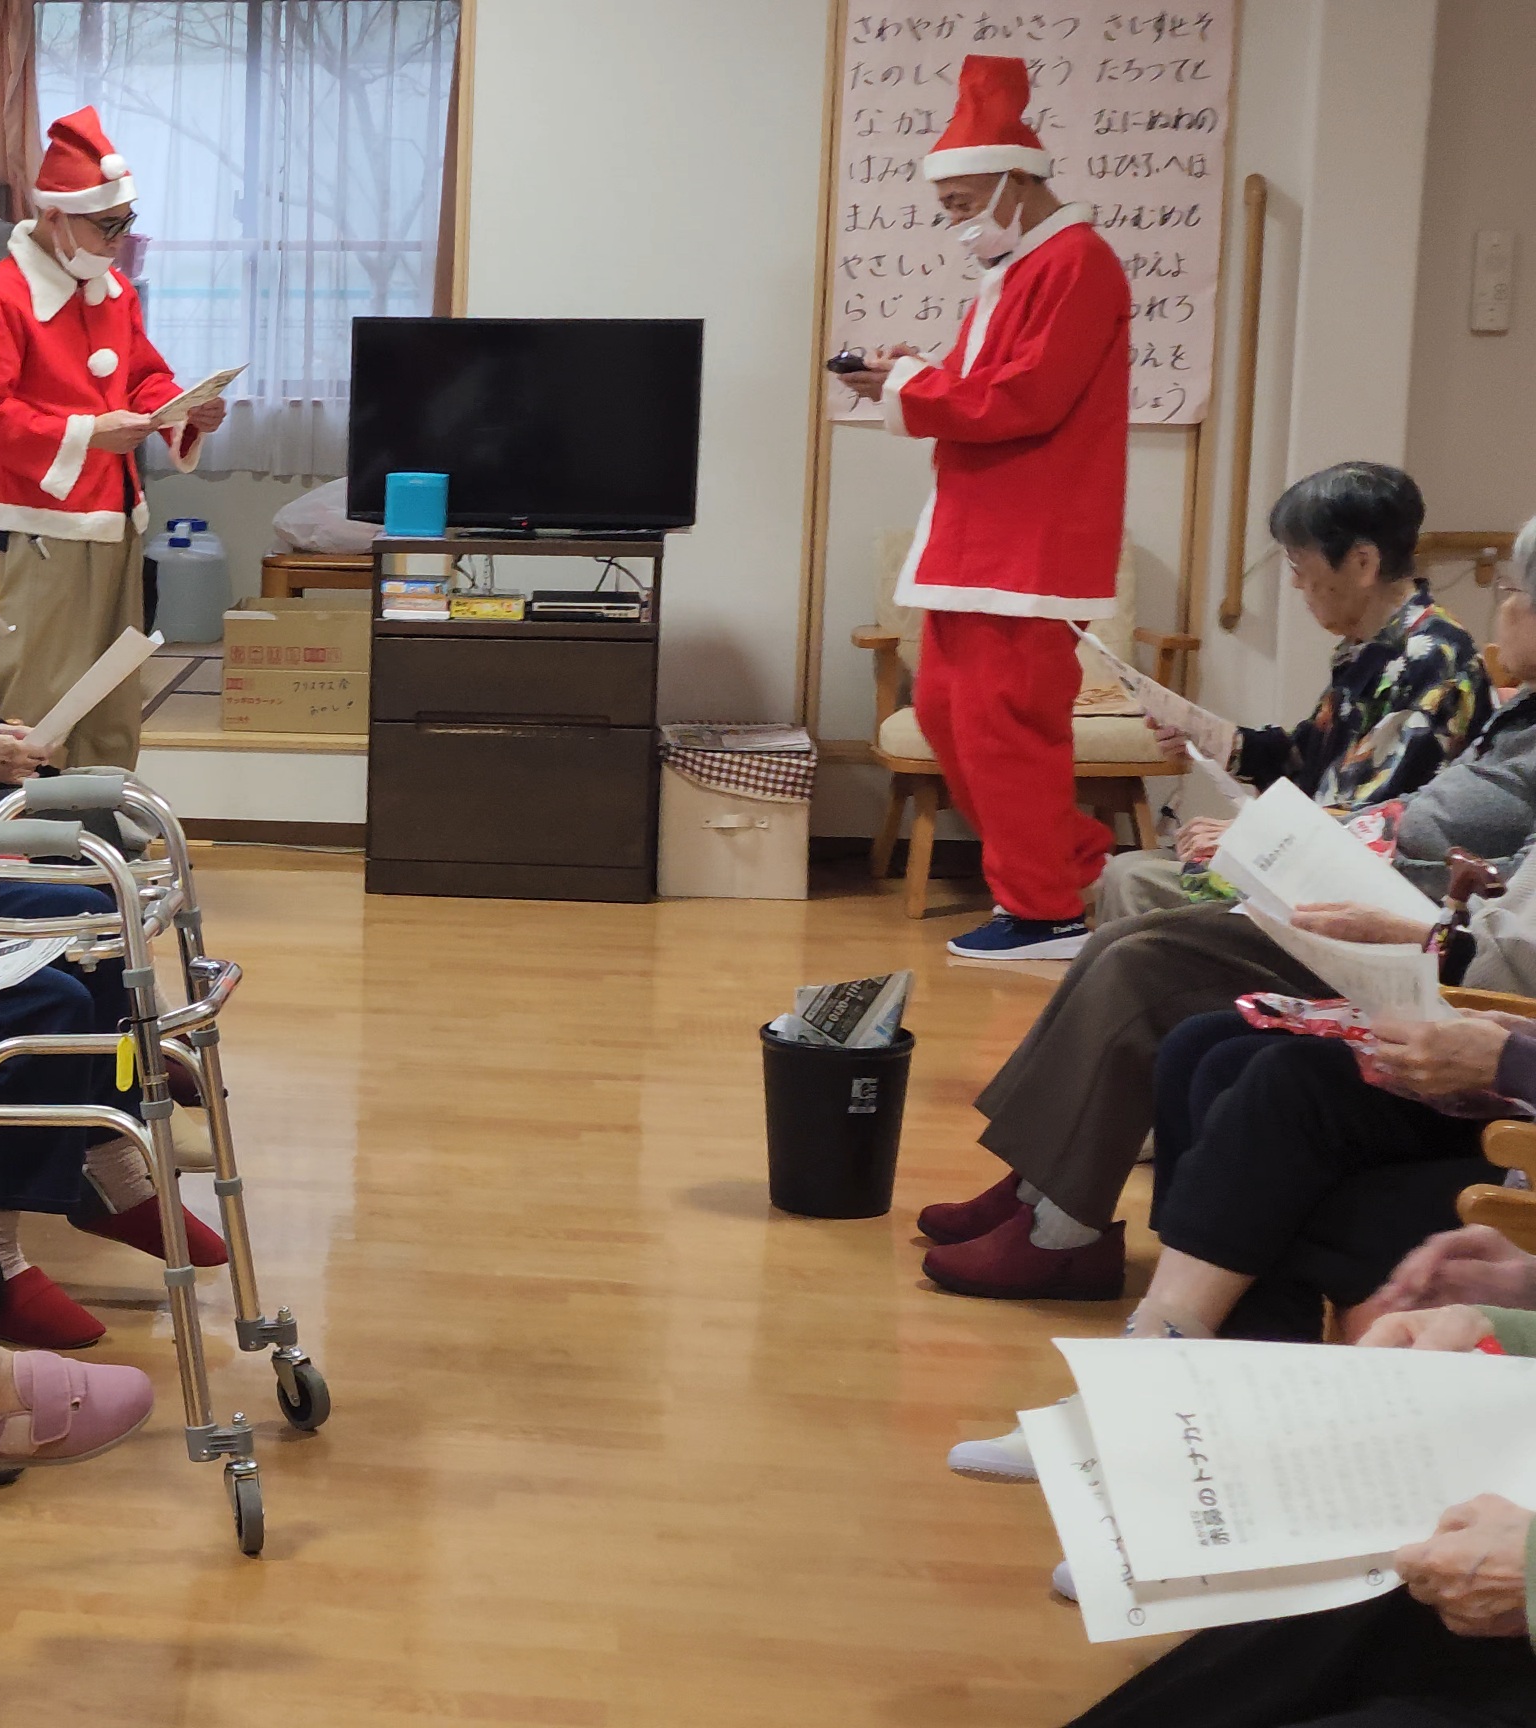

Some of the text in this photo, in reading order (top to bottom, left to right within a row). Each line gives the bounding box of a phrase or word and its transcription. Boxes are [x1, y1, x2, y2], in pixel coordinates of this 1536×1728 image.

[973, 12, 1080, 42] あいさつ
[1103, 12, 1214, 44] さしすせそ
[851, 61, 953, 90] たのしく
[854, 107, 956, 136] なかよ
[1087, 152, 1212, 179] はひふへほ
[839, 253, 946, 280] やさしい
